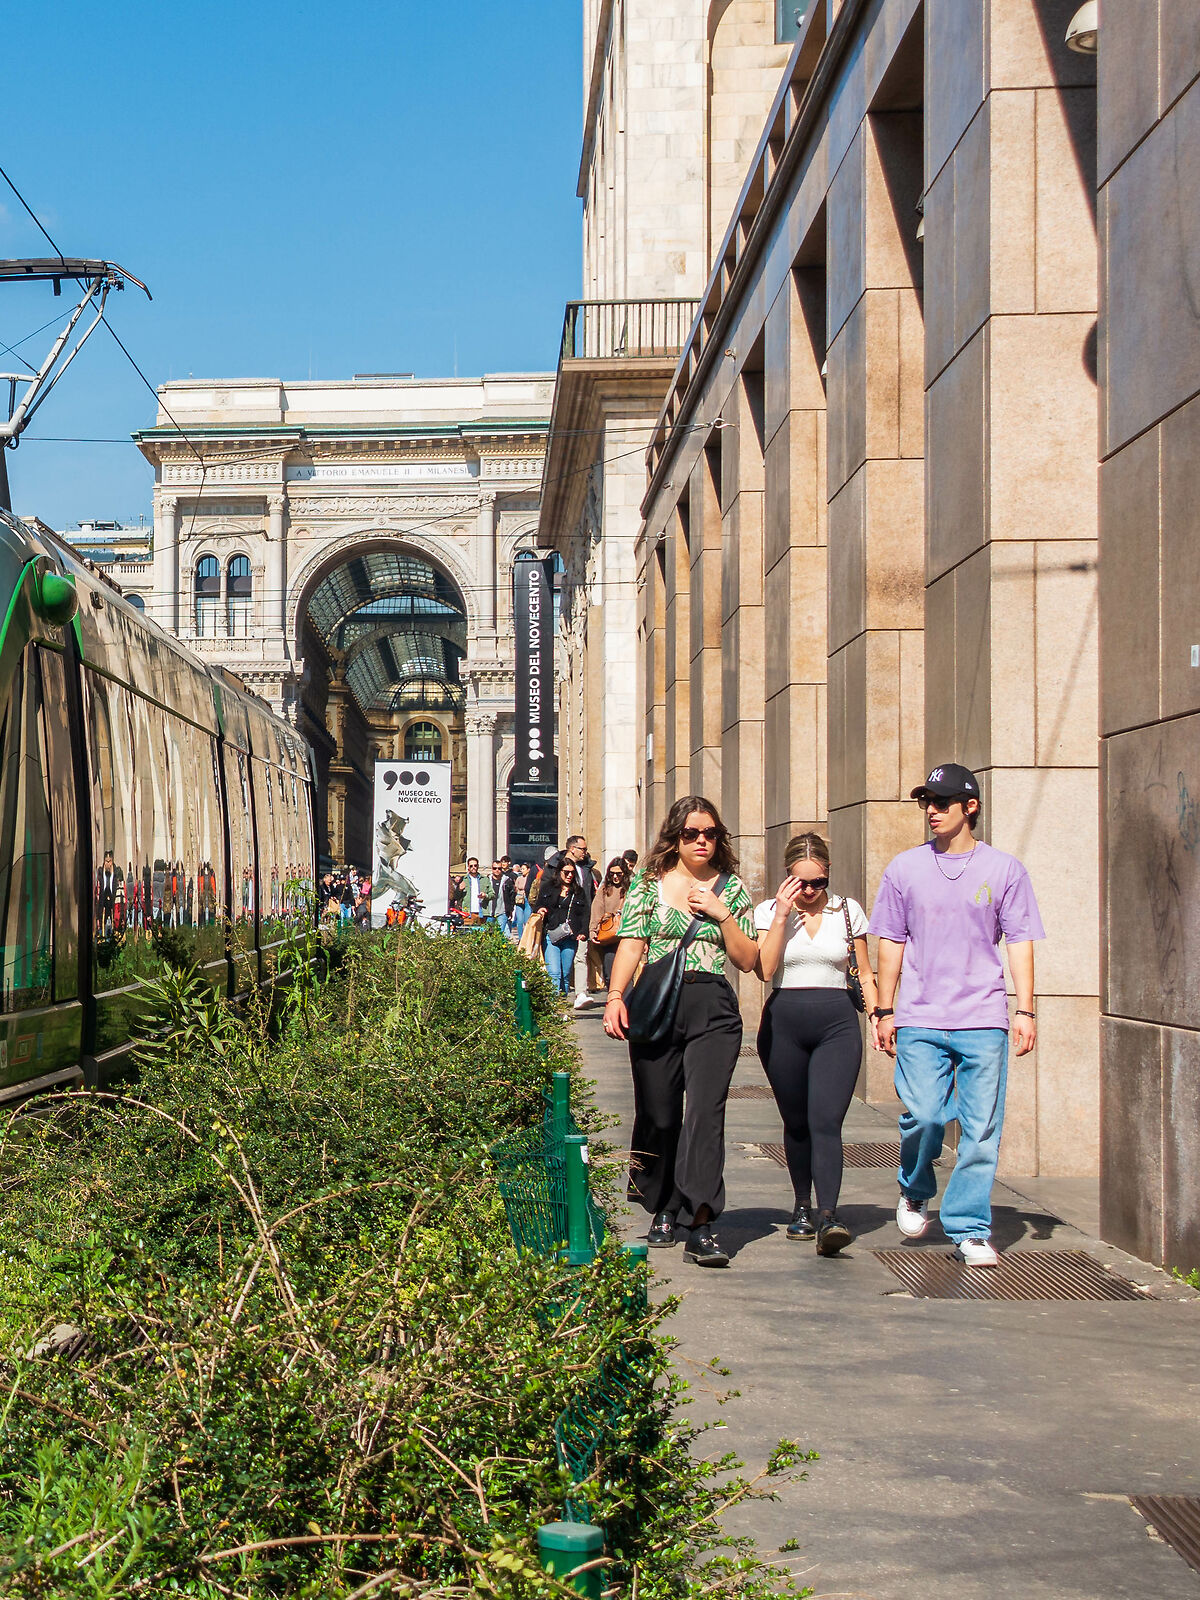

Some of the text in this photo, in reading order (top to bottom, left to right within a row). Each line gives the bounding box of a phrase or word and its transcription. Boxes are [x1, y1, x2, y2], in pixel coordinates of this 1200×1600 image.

[307, 469, 347, 477] VITTORIO
[352, 468, 399, 476] EMANUELE
[529, 570, 540, 648] NOVECENTO
[529, 651, 540, 674] DEL
[529, 678, 540, 724] MUSEO
[928, 769, 943, 782] NY
[528, 834, 551, 842] Motta
